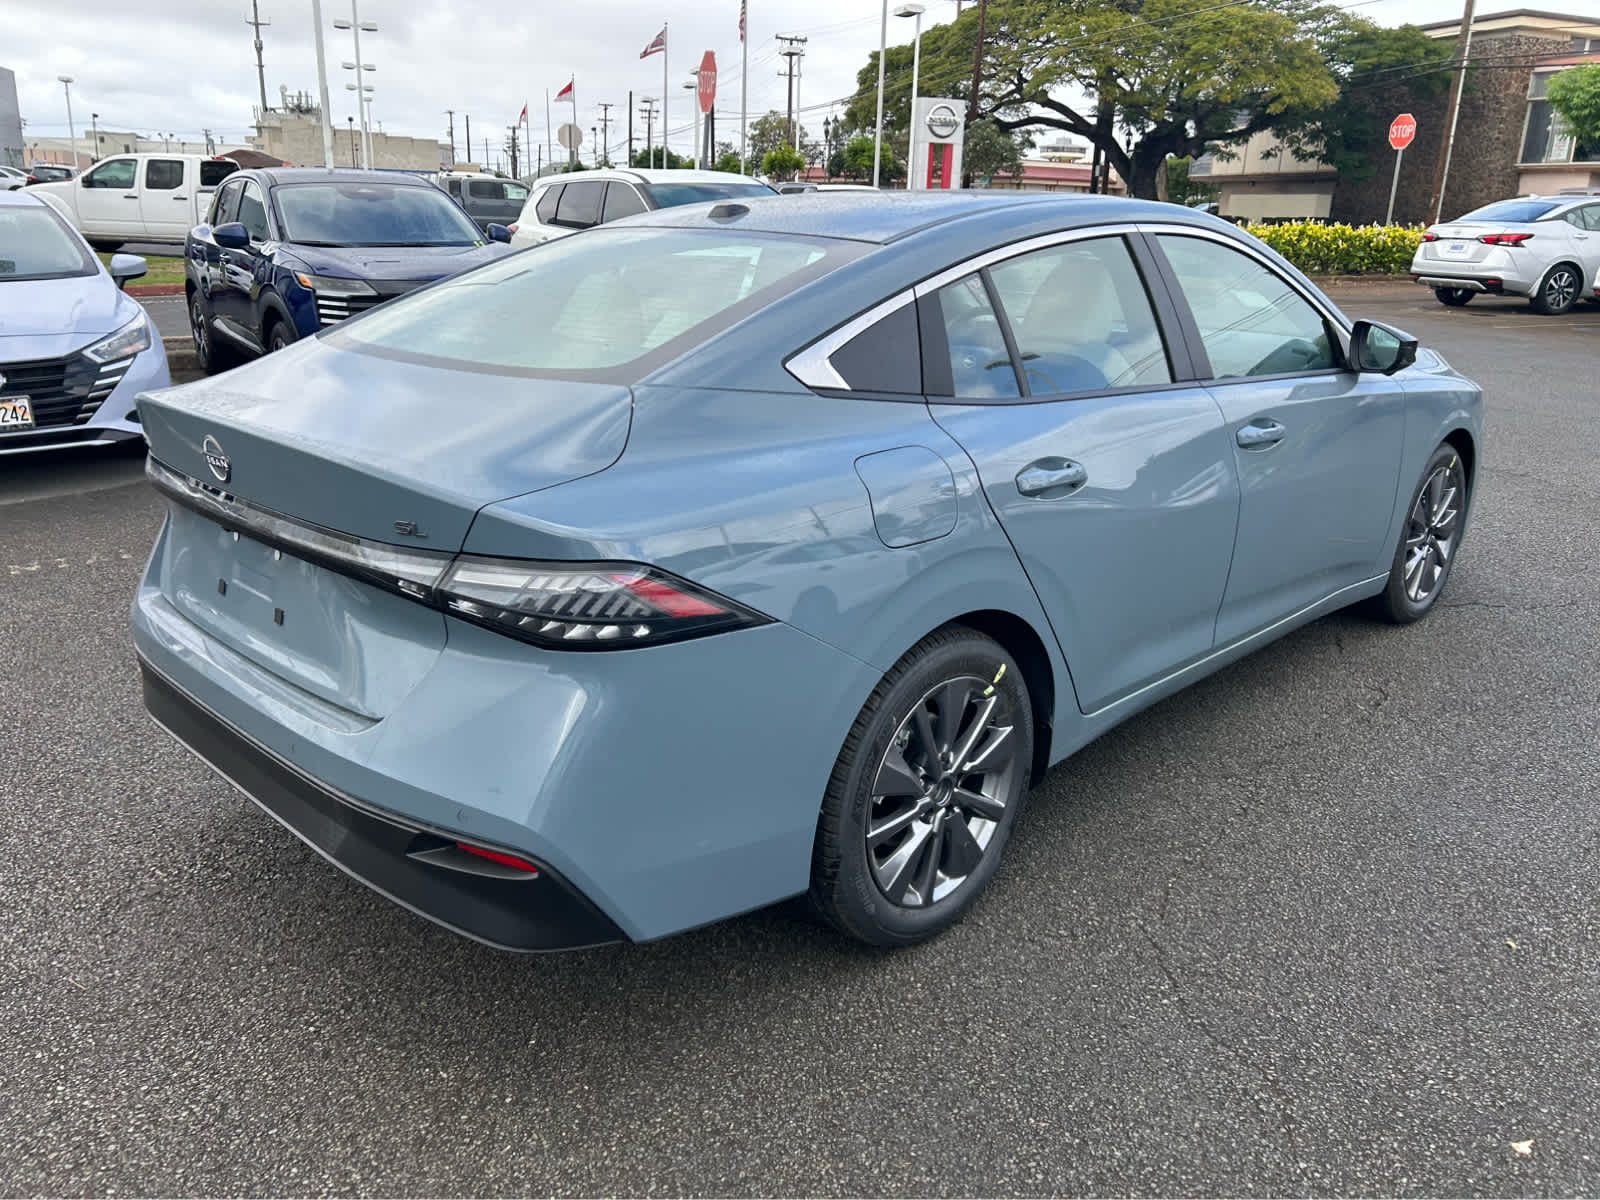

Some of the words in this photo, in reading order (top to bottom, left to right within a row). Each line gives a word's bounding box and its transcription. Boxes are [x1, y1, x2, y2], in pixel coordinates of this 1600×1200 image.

[700, 71, 715, 93] STOP
[1391, 124, 1414, 138] STOP
[0, 405, 29, 422] 242
[393, 520, 428, 537] SL
